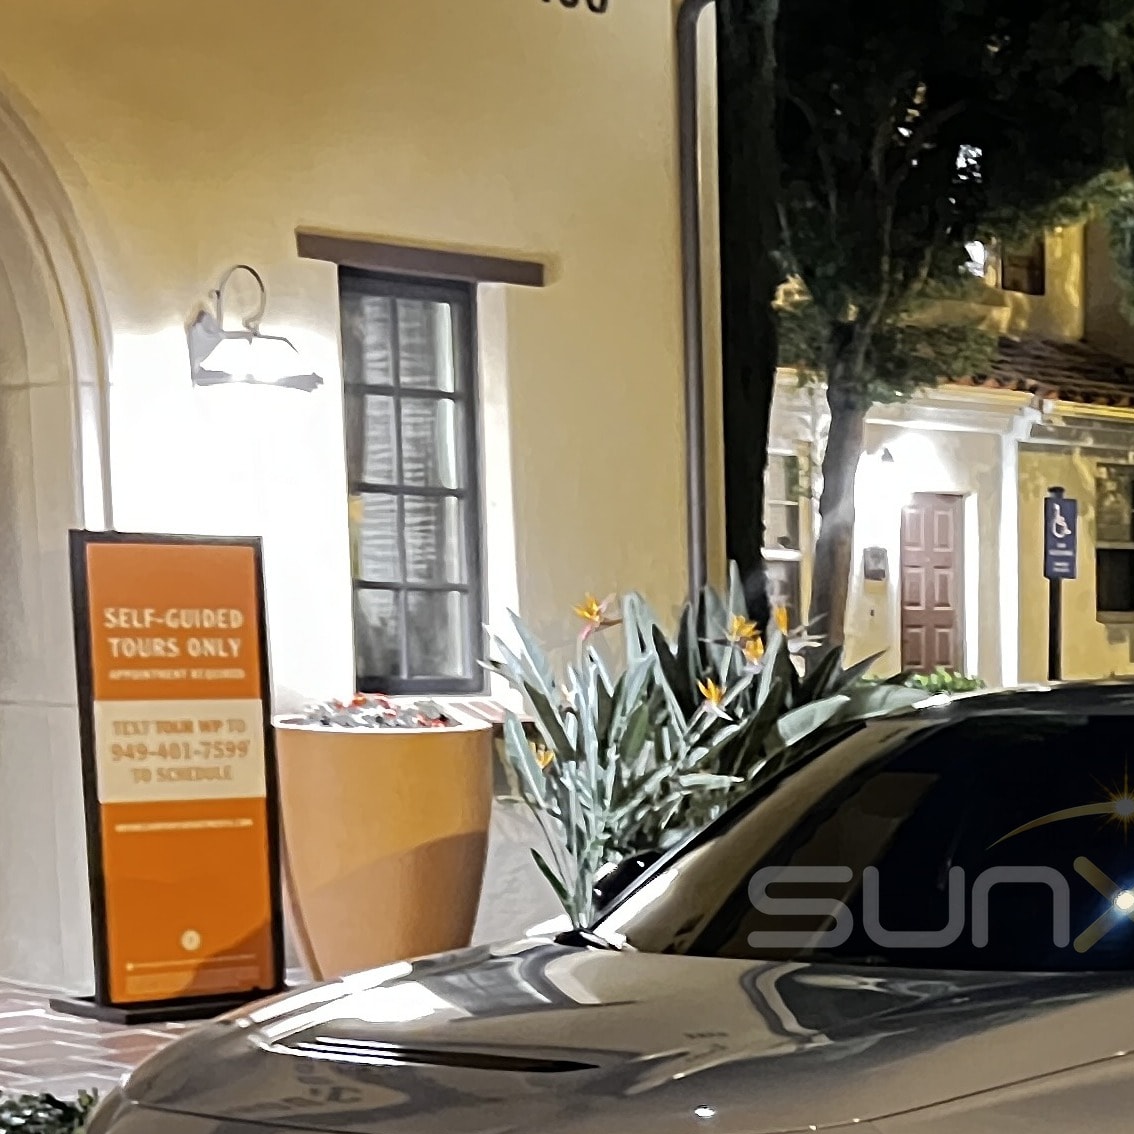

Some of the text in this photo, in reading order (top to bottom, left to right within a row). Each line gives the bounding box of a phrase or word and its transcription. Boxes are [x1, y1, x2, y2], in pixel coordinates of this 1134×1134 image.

[103, 608, 243, 628] SELF-GUIDED
[107, 637, 241, 658] TOURS ONLY
